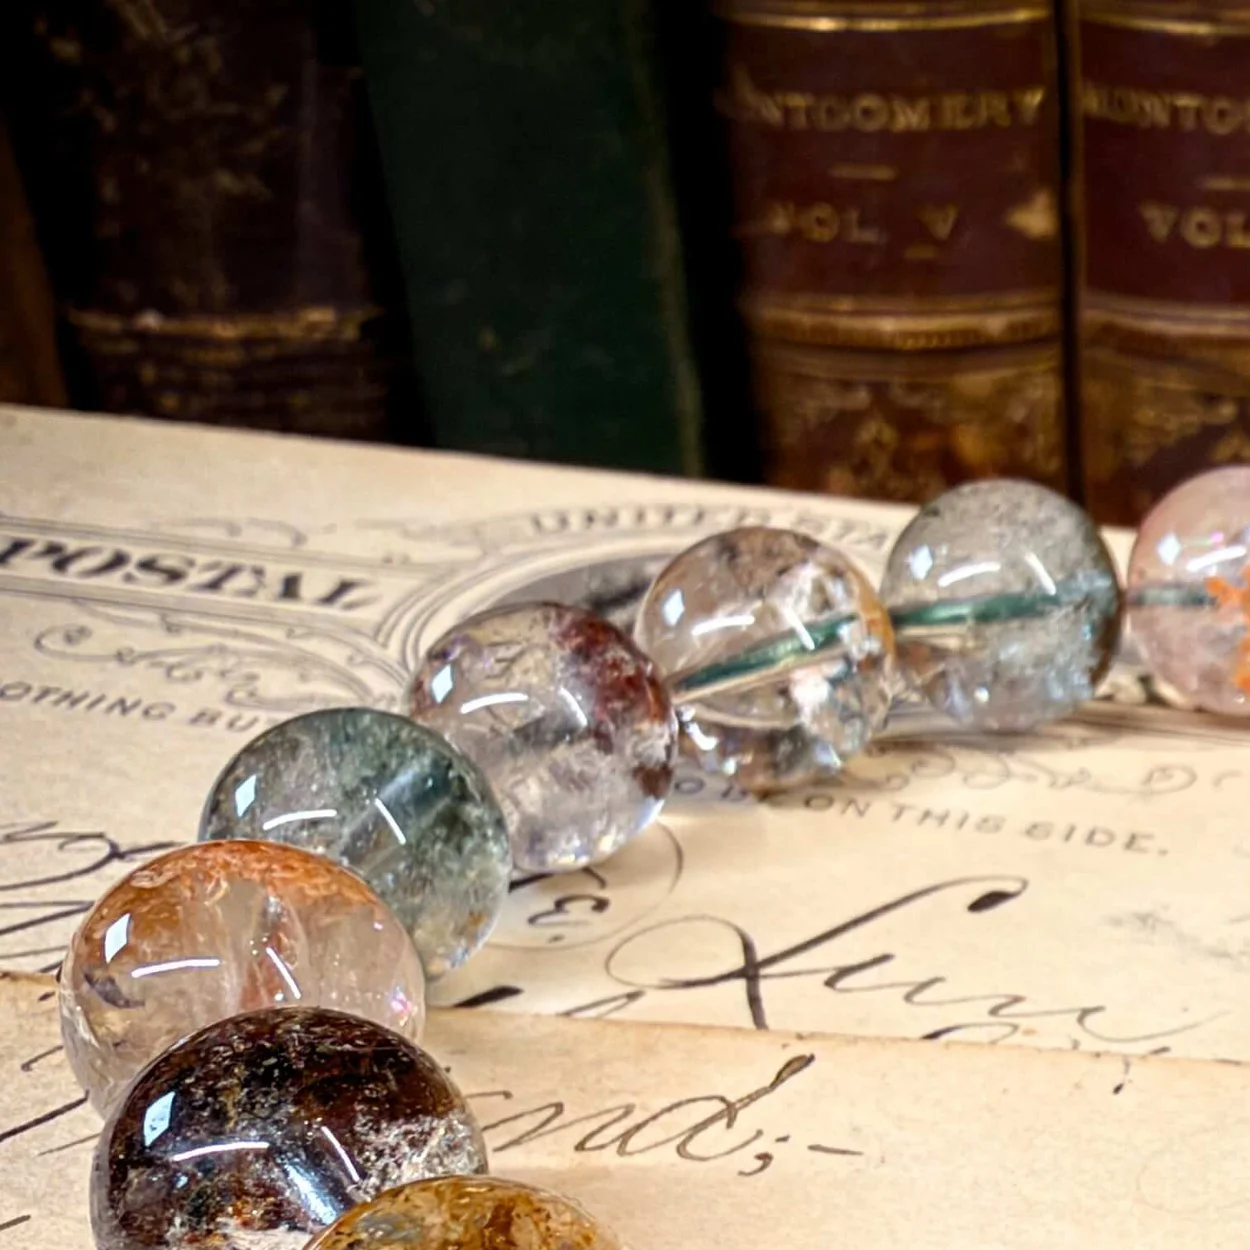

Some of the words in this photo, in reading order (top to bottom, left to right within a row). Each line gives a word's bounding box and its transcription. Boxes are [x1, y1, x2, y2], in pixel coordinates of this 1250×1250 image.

[0, 680, 177, 722] OTHING
[190, 709, 285, 734] BU
[803, 795, 870, 818] ON
[894, 806, 1007, 836] THIS
